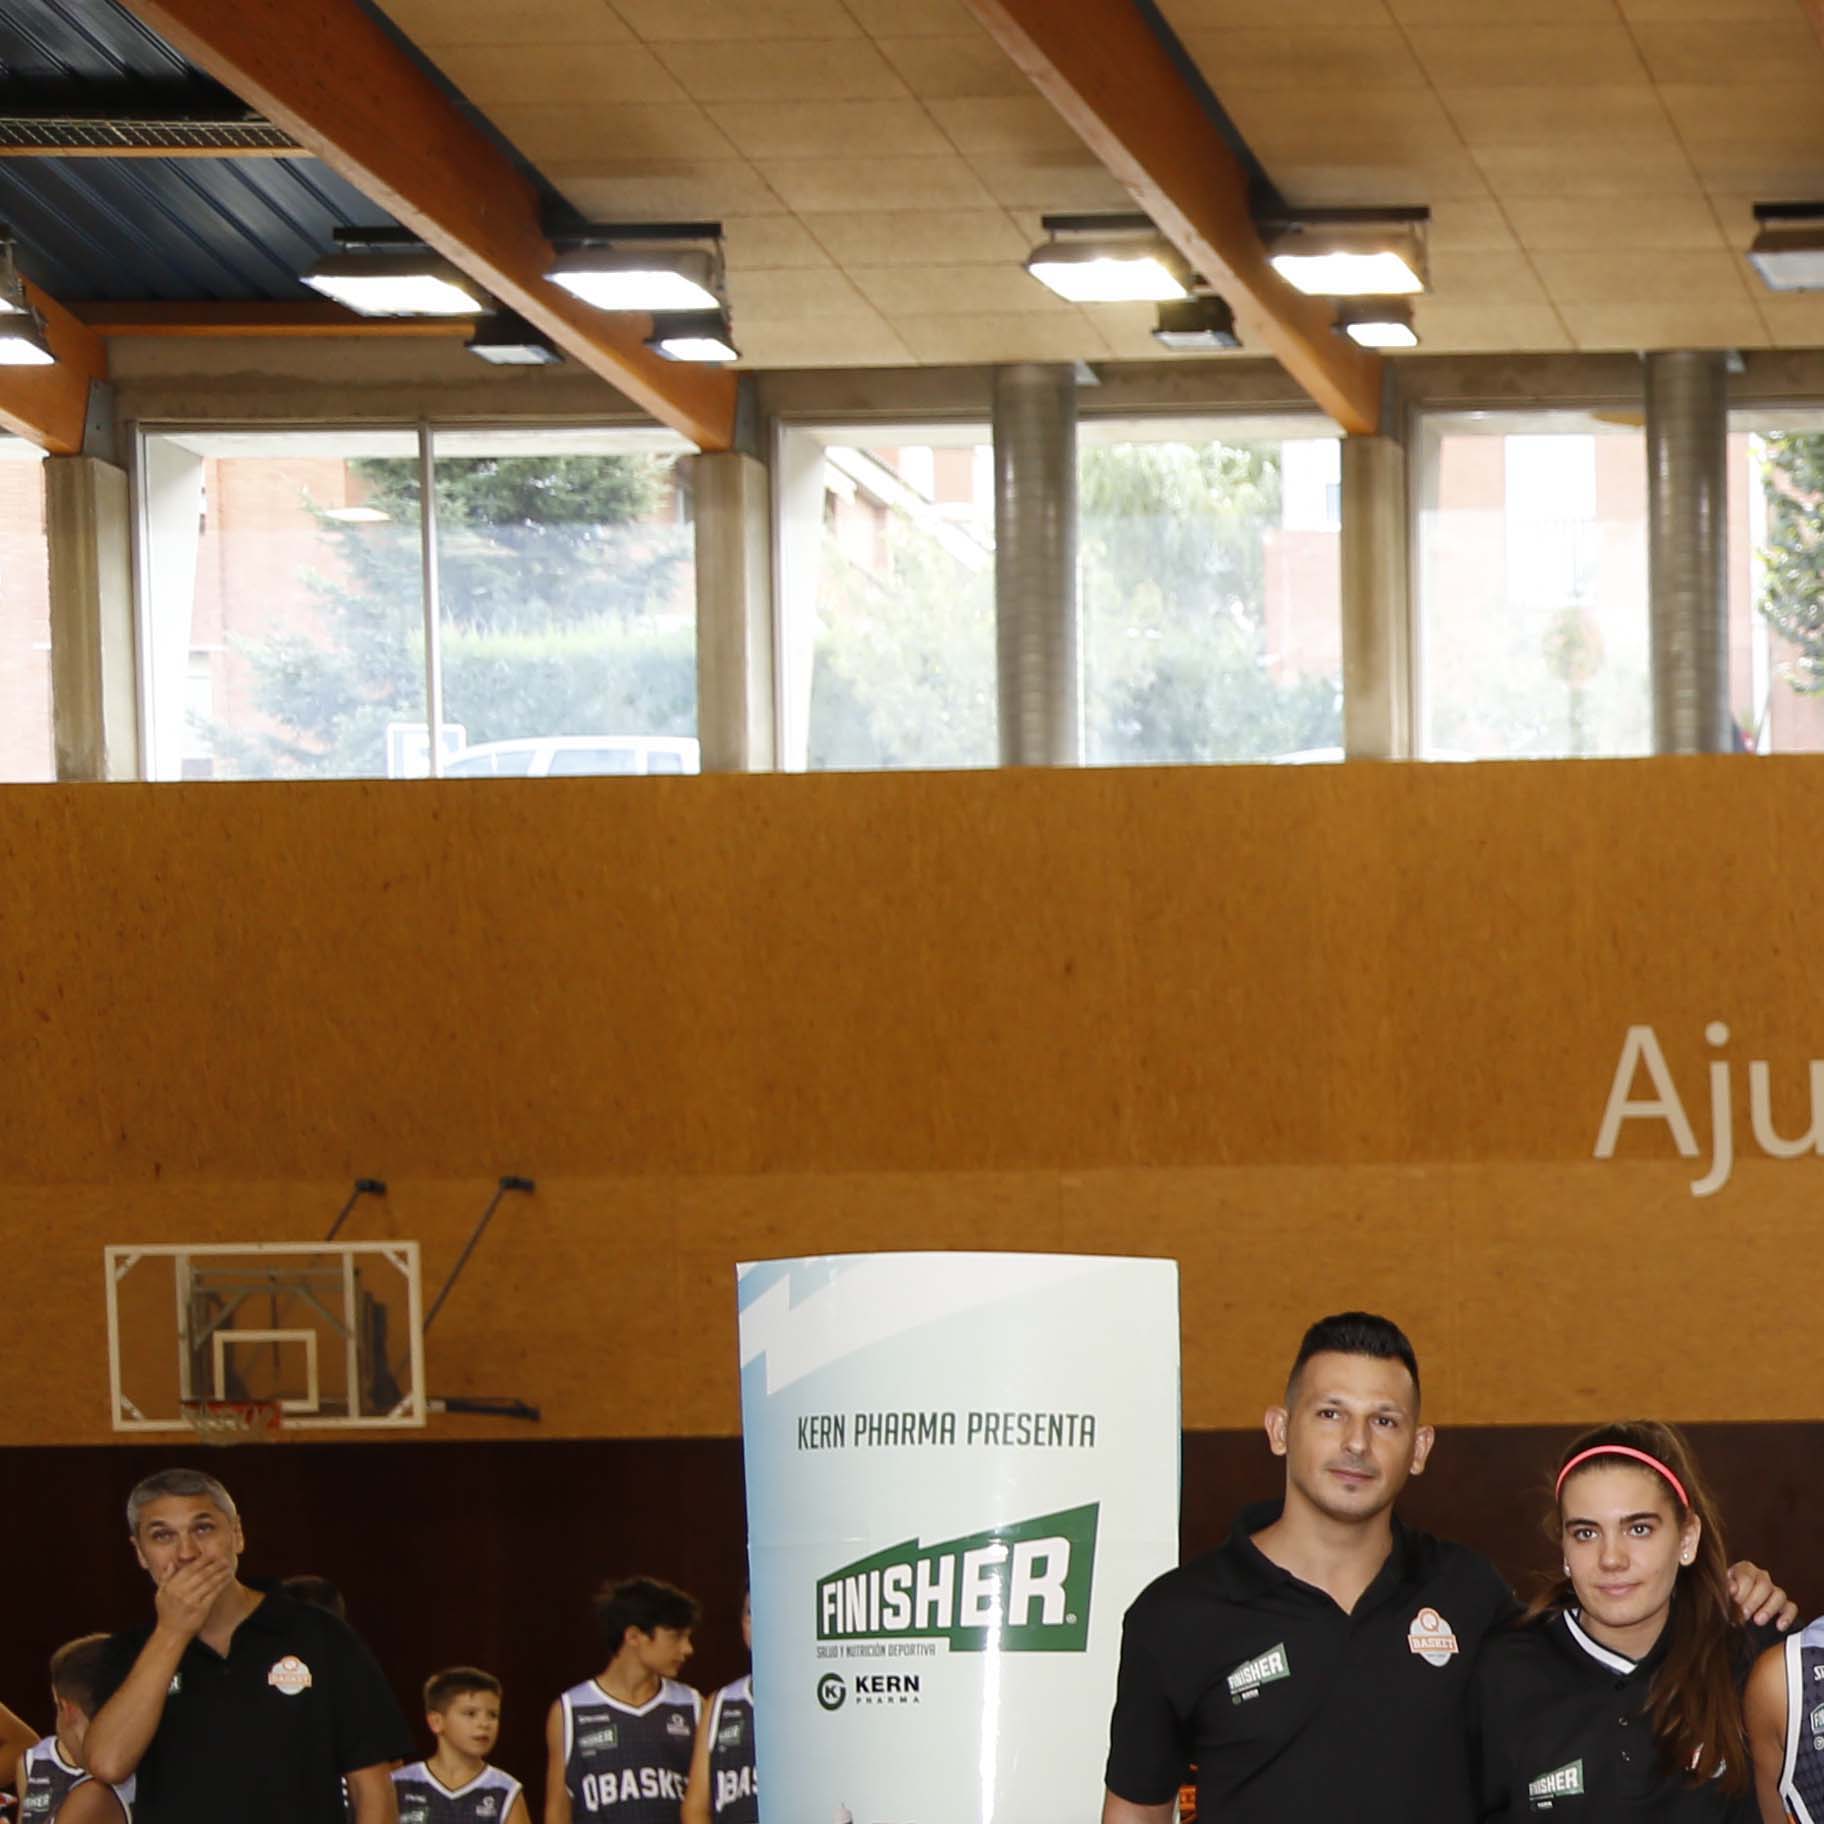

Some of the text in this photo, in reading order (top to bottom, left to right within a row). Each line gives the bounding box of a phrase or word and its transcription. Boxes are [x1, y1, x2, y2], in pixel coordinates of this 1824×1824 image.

[799, 1412, 1096, 1449] KERN PHARMA PRESENTA
[817, 1643, 935, 1658] SALUD Y NUTRICIÓN DEPORTIVA
[1228, 1651, 1283, 1690] FINISHER
[856, 1676, 919, 1693] KERN
